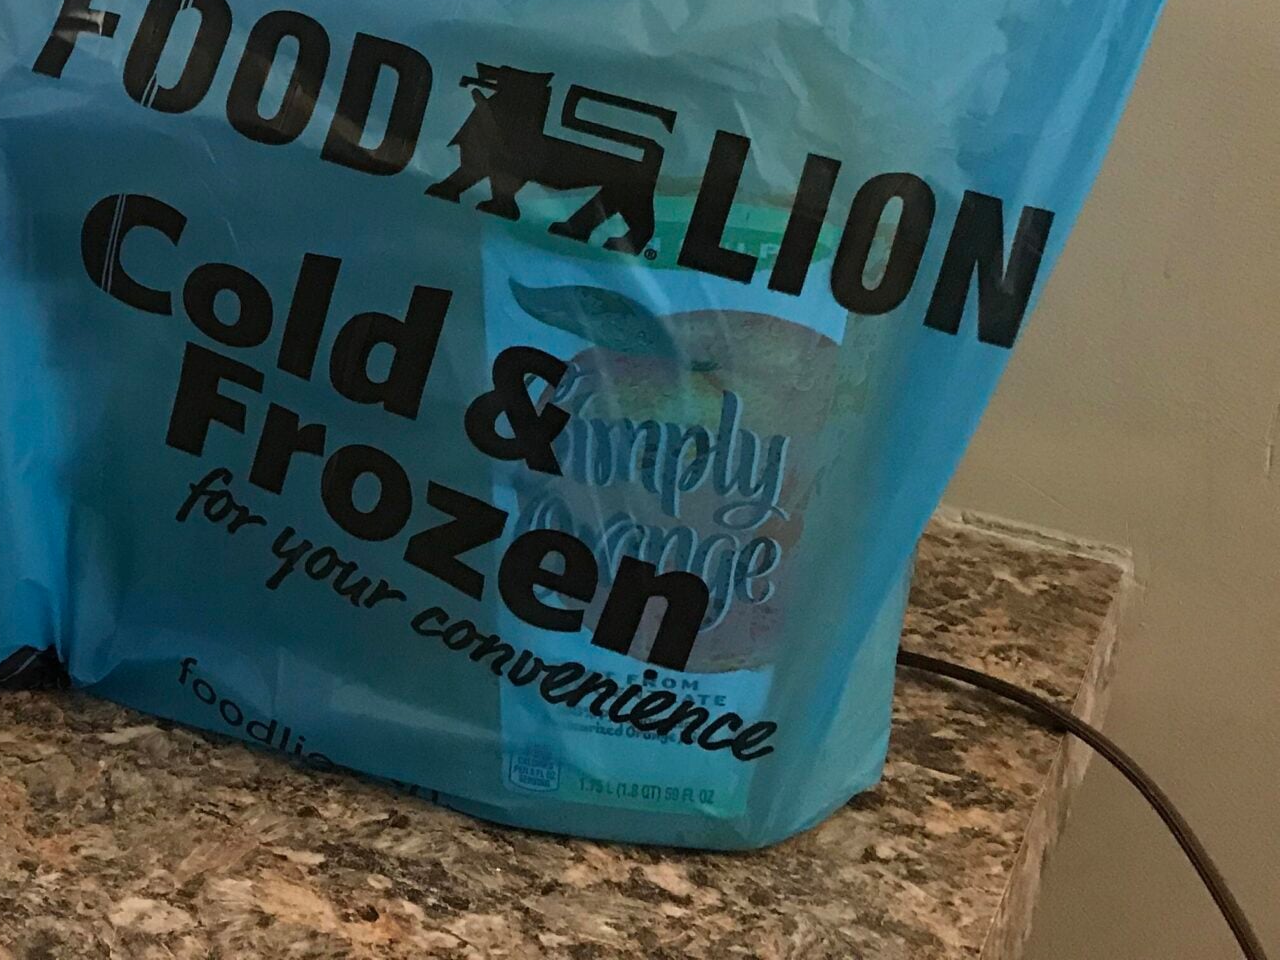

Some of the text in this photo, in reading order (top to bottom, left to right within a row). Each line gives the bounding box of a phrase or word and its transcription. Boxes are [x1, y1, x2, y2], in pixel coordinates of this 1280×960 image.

[80, 193, 571, 477] Cold &
[677, 129, 1056, 349] LION
[165, 341, 710, 673] Frozen
[176, 466, 778, 762] for your convenience
